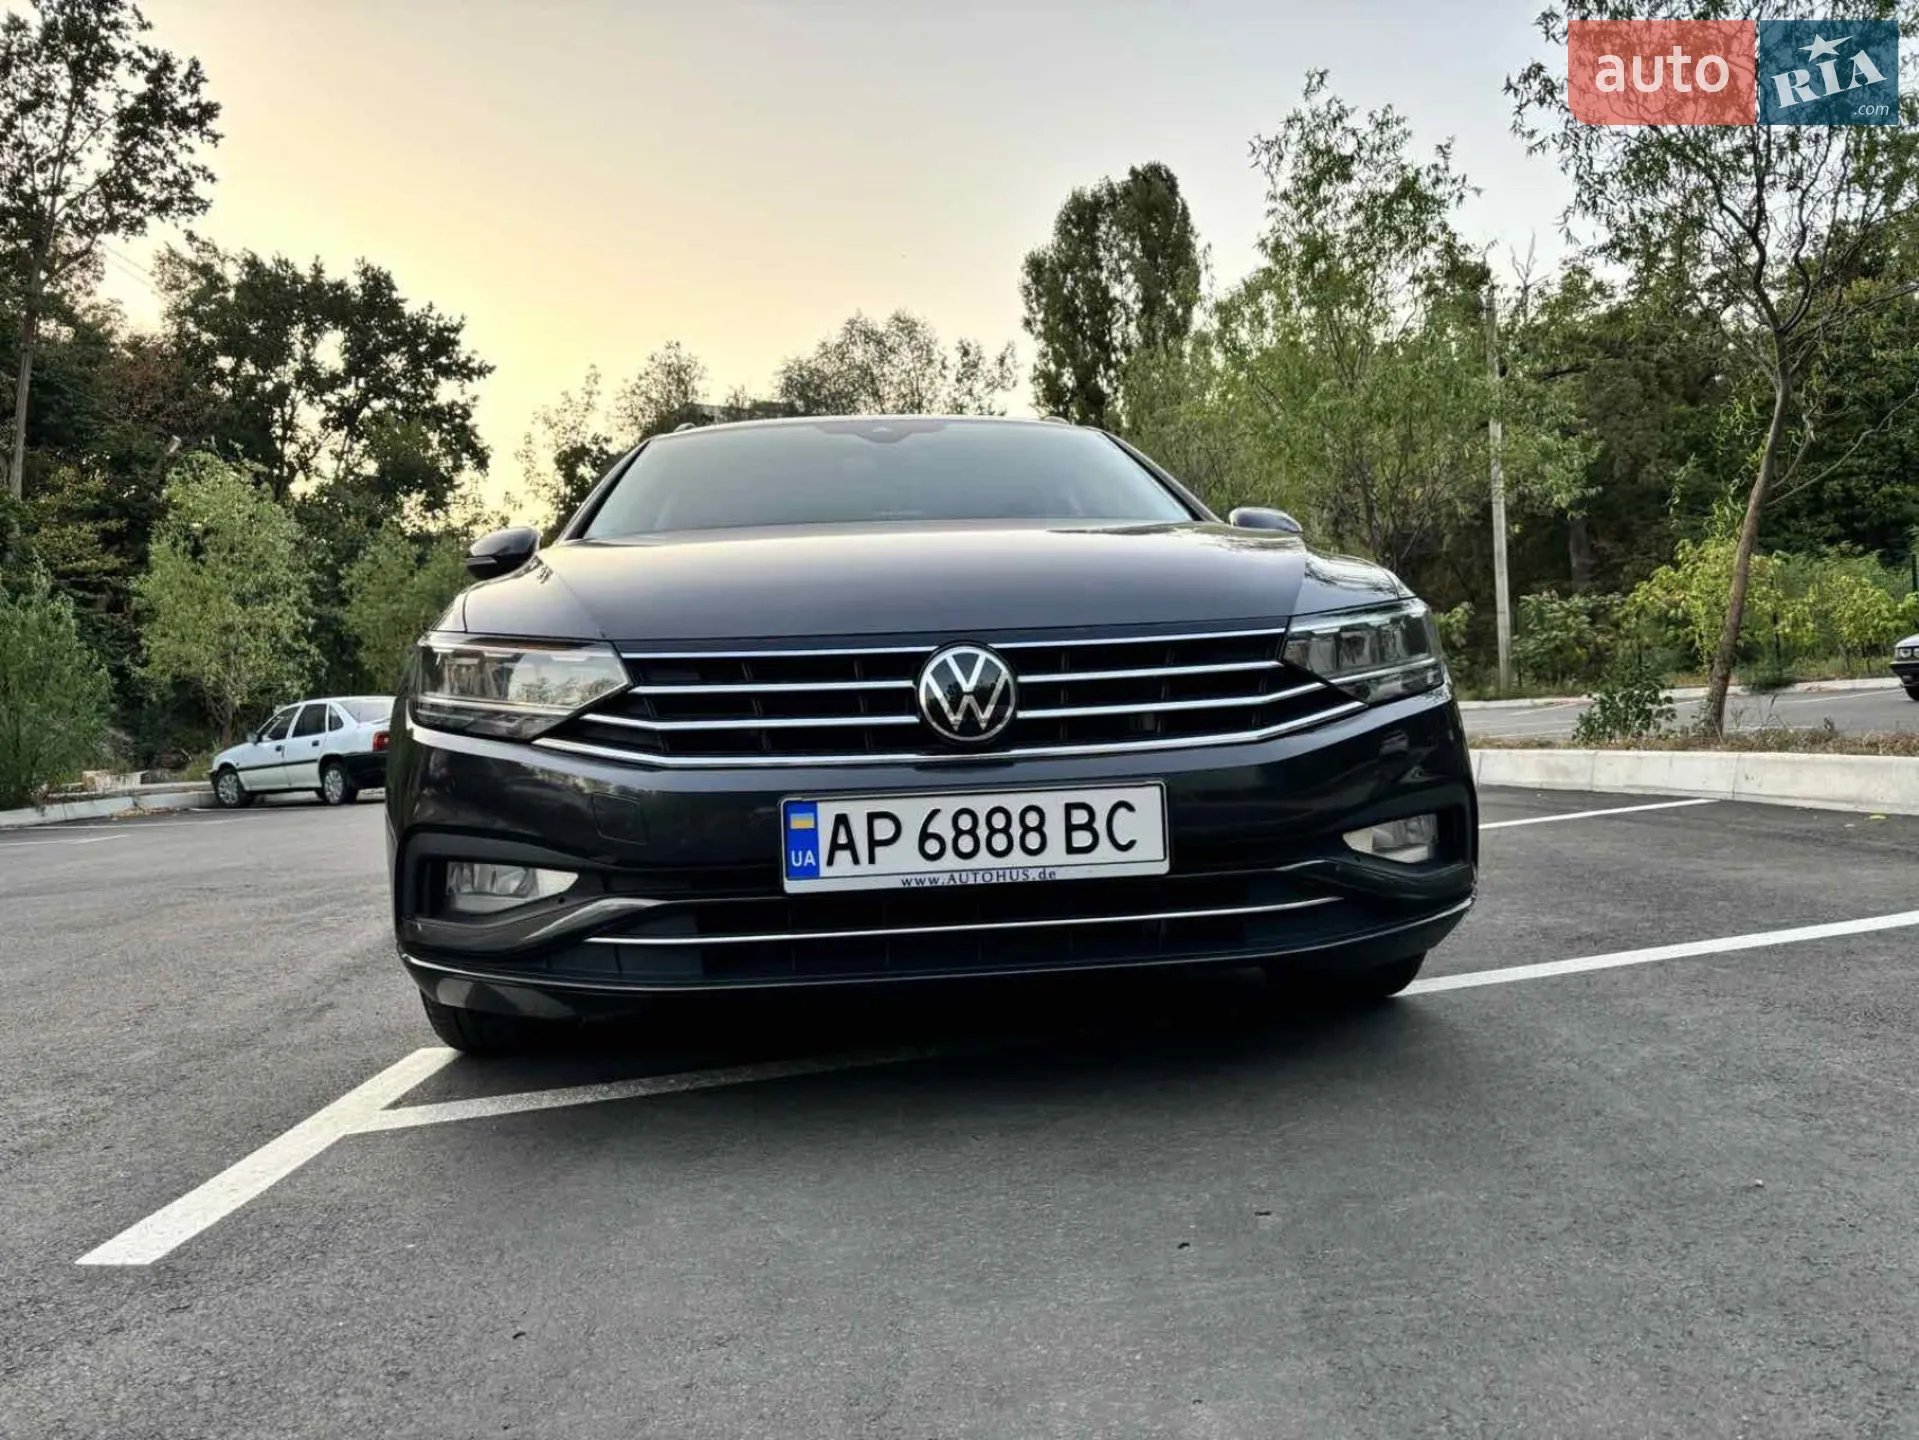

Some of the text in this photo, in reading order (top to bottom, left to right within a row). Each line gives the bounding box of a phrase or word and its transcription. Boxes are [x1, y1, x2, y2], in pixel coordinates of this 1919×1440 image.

[826, 800, 1137, 866] AP 6888 BC
[791, 850, 816, 867] UA
[901, 869, 1056, 887] www.AUTOHUS.de
